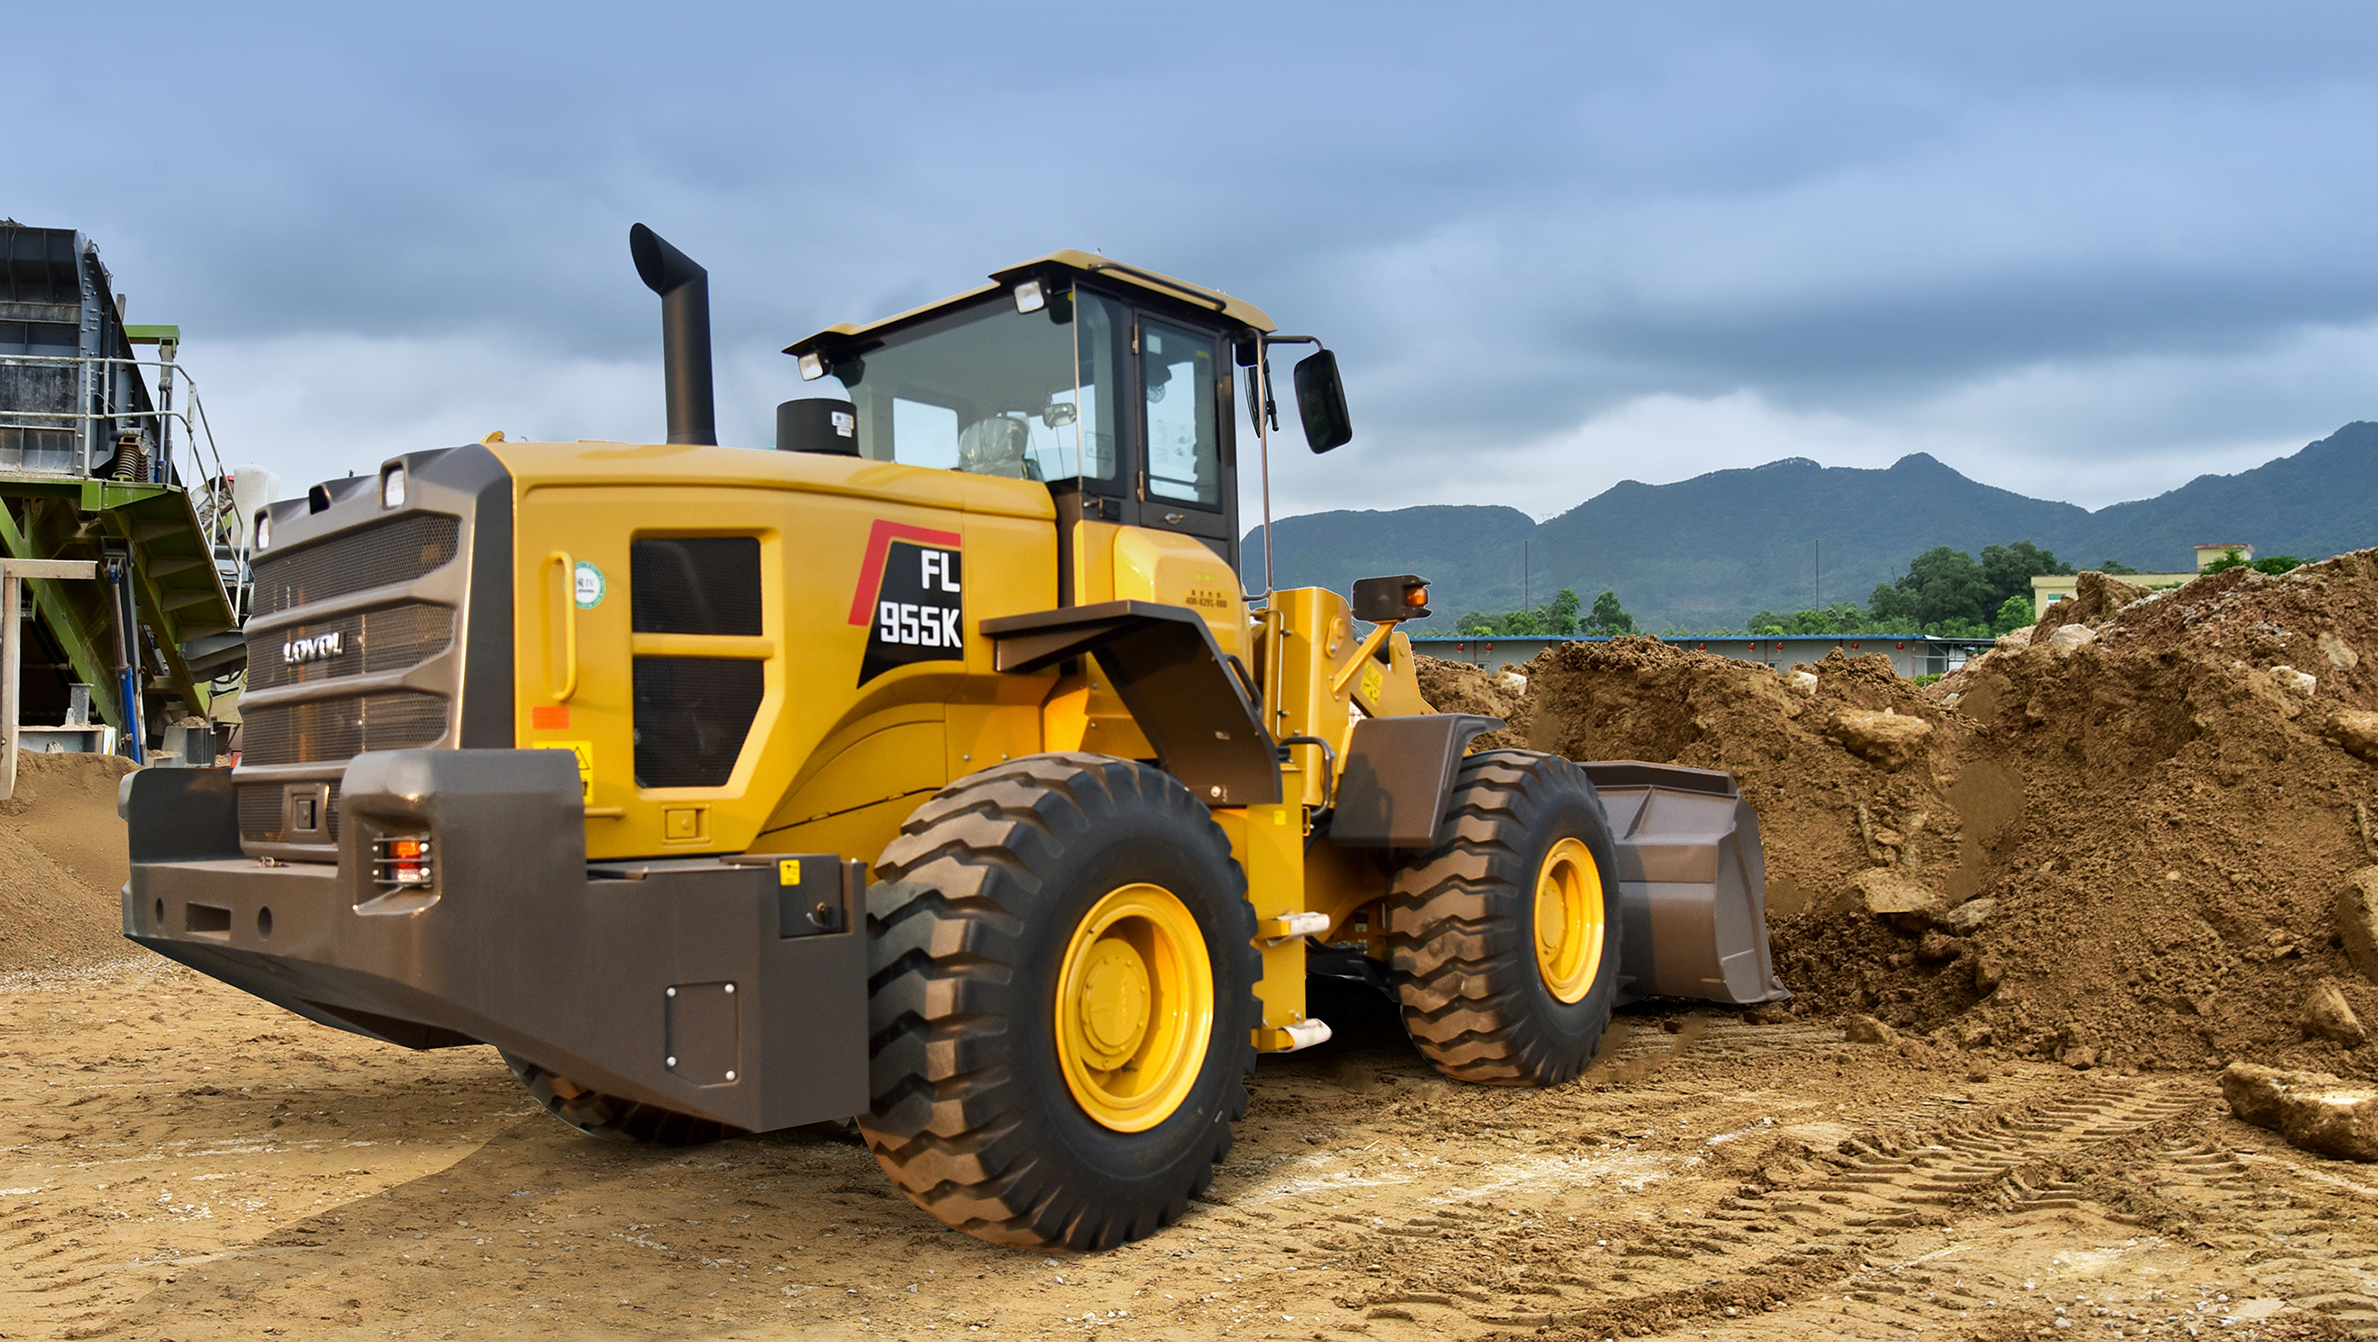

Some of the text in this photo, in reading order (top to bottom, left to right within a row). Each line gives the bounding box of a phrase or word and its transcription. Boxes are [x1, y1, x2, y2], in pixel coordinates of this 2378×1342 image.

[921, 549, 961, 593] FL
[880, 600, 963, 648] 955K
[283, 632, 343, 664] LOVOL
